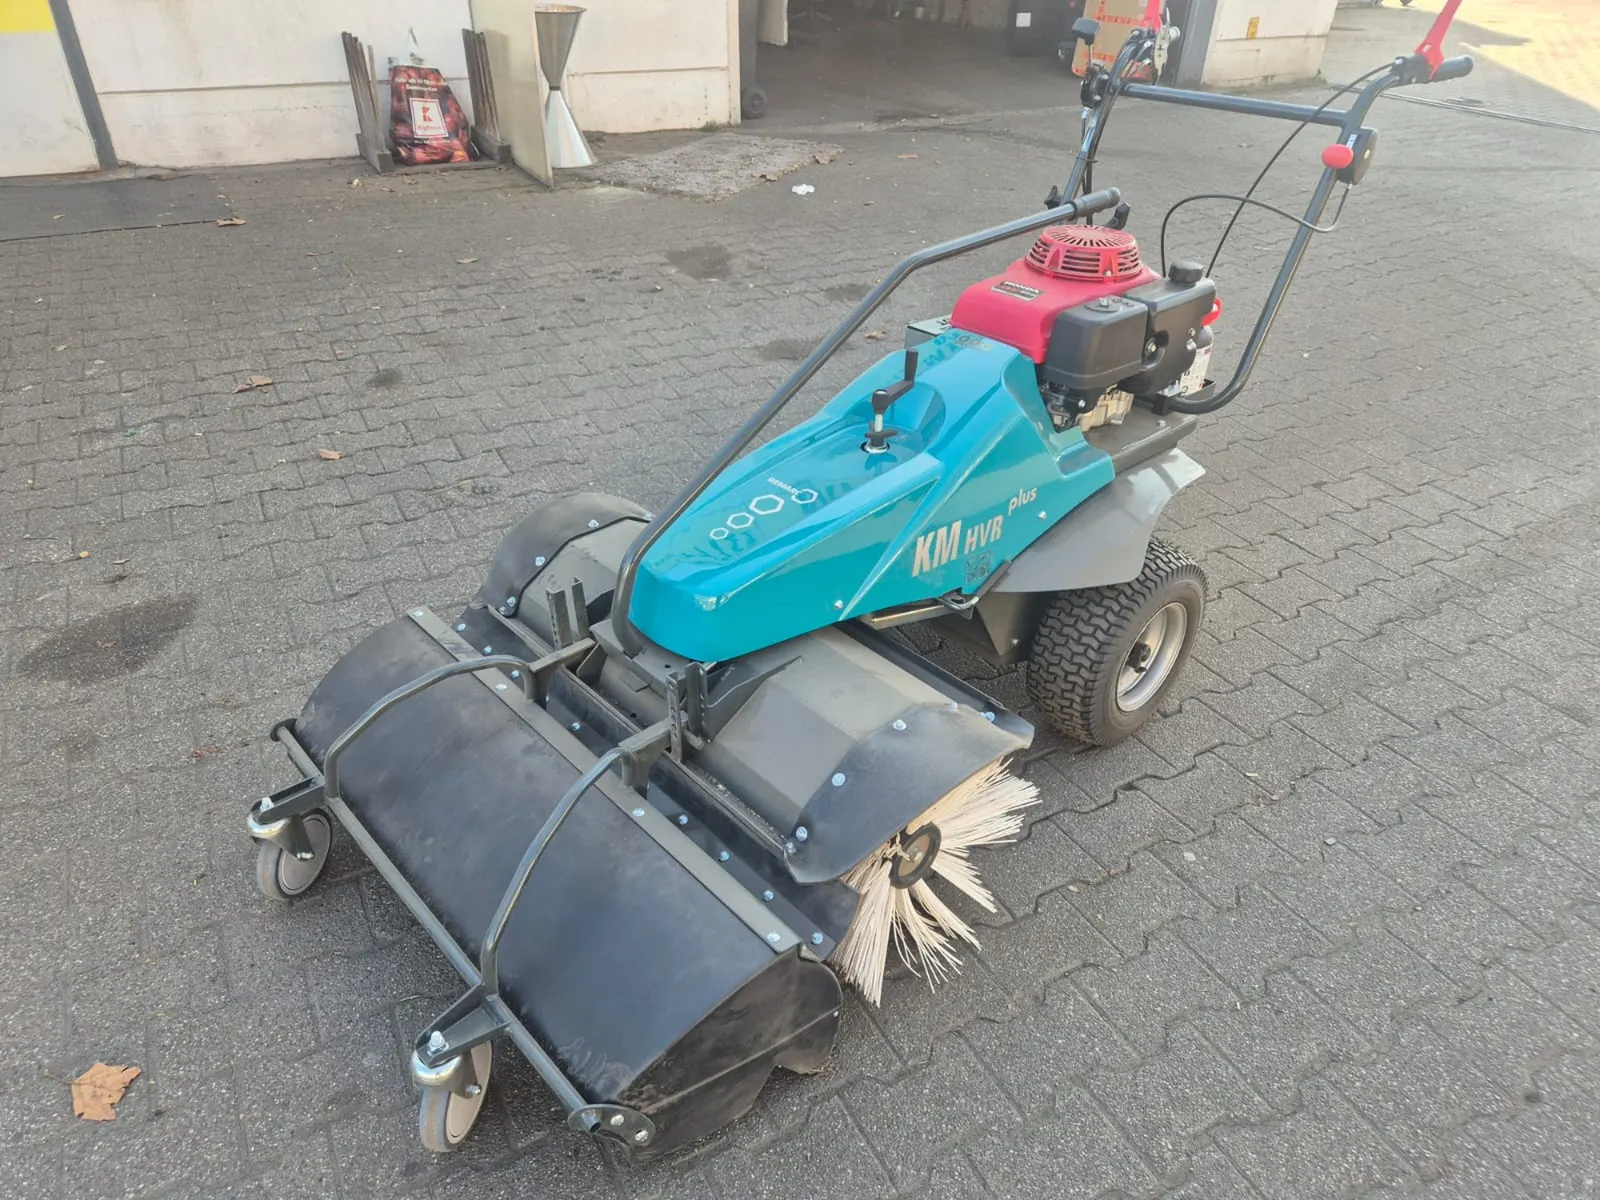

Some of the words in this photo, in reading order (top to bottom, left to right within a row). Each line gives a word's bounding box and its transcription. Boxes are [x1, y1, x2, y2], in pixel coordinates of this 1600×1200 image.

[912, 519, 962, 577] KM
[963, 515, 1004, 555] HVR
[1007, 487, 1037, 516] plus
